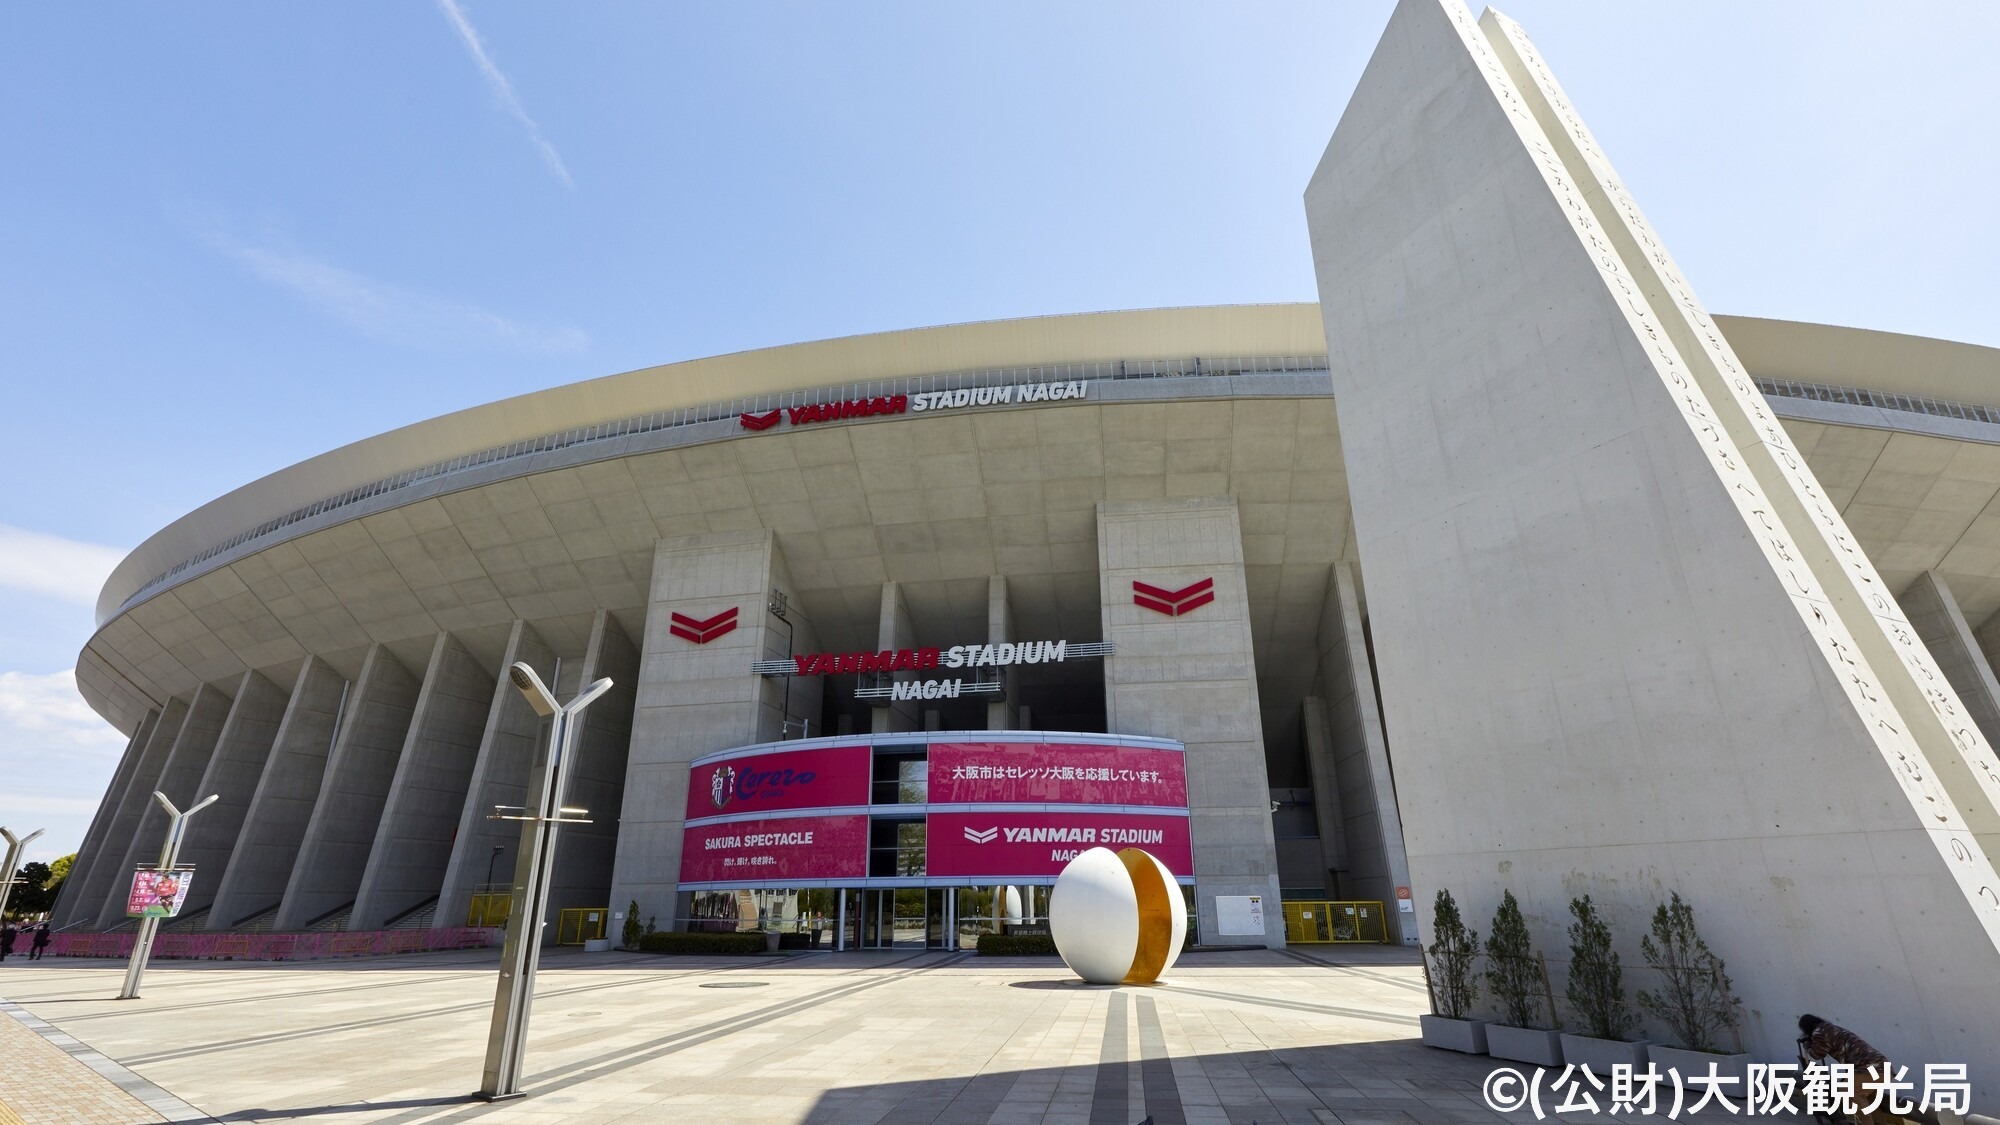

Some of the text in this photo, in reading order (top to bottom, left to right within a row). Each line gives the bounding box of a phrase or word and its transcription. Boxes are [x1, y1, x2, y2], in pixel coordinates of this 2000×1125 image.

[786, 380, 1088, 425] YANMAR STADIUM NAGAI
[794, 640, 1066, 676] YANMAR STADIUM
[891, 679, 961, 701] NAGAI
[736, 766, 816, 800] Cerezo
[952, 766, 1163, 784] 大阪市はセレッソ大阪を応援しています。
[705, 832, 813, 850] SAKURA SPECTACLE
[1003, 828, 1163, 844] YANMAR STADIUM
